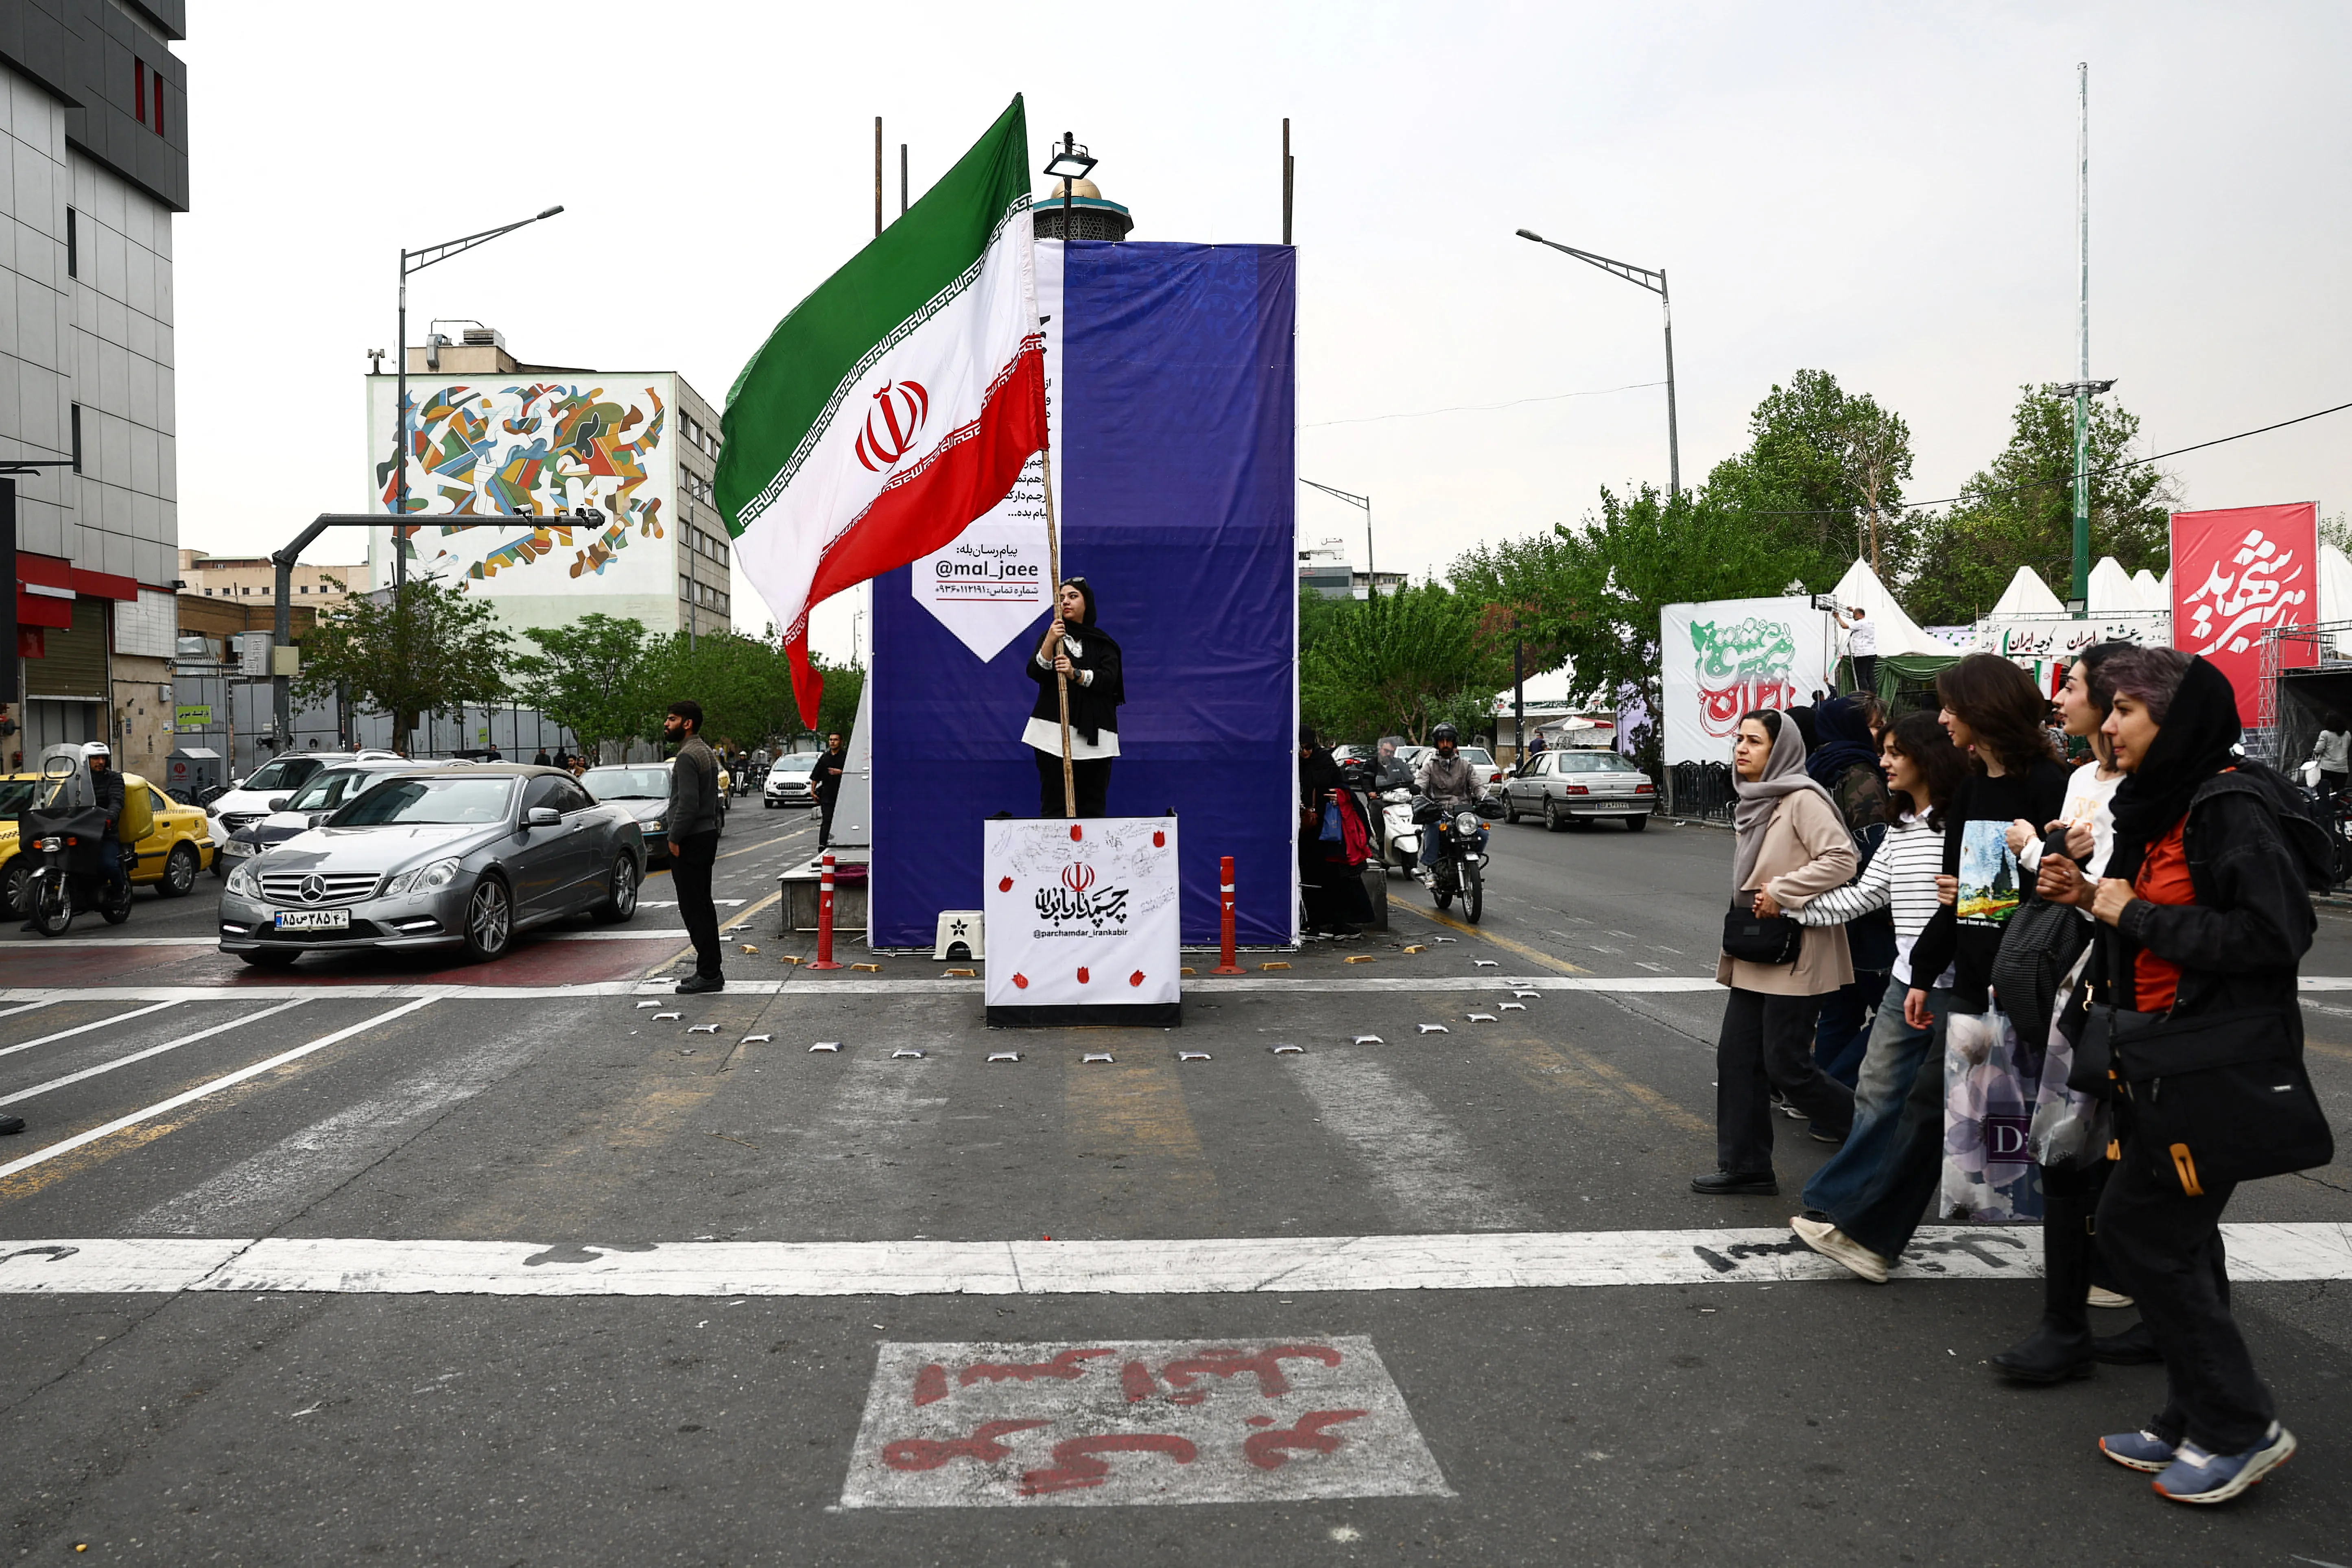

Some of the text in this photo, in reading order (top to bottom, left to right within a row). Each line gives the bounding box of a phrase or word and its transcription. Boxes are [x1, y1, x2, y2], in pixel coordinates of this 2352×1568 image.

[1321, 537, 1343, 546] هتل
[936, 560, 1039, 580] @mal_jaee
[1014, 585, 1039, 597] شماره
